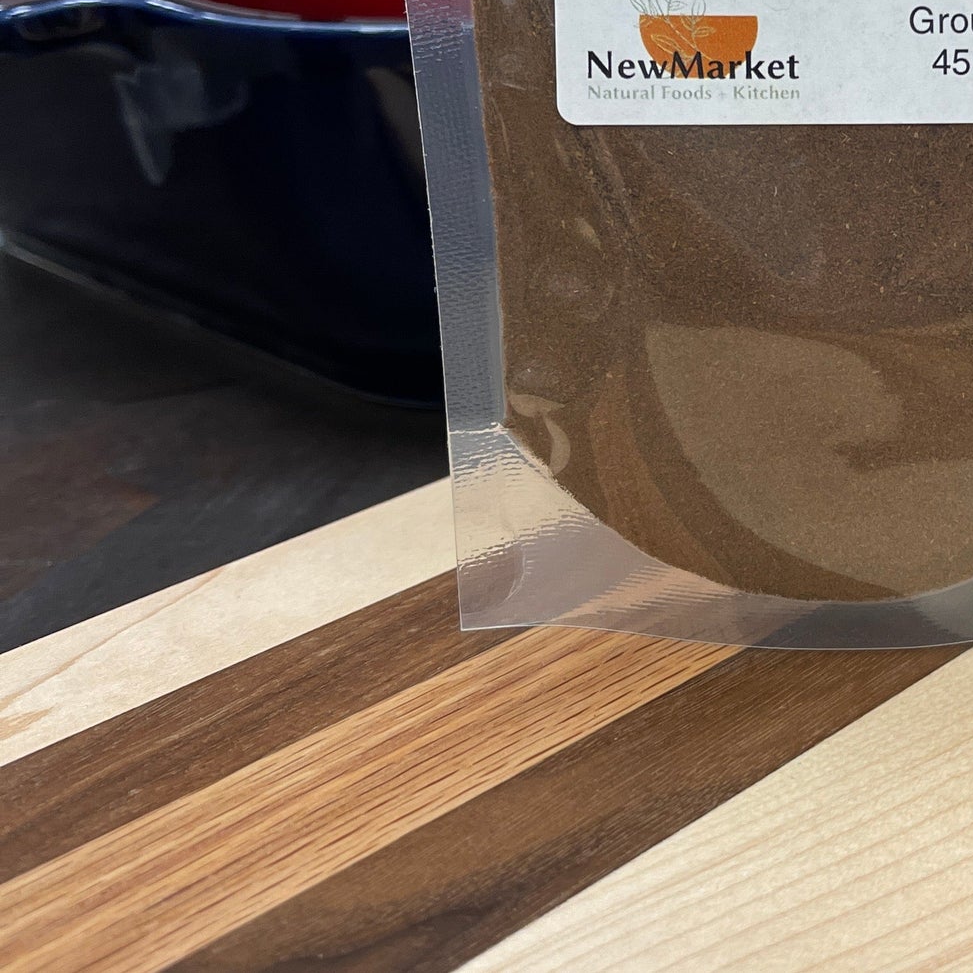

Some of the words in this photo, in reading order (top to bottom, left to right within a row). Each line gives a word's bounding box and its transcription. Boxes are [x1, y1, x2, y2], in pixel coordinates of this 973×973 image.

[587, 49, 800, 80] NewMarket
[932, 48, 971, 76] 45
[587, 84, 655, 100] Natural
[661, 84, 712, 100] Foods
[733, 84, 801, 100] Kitchen
